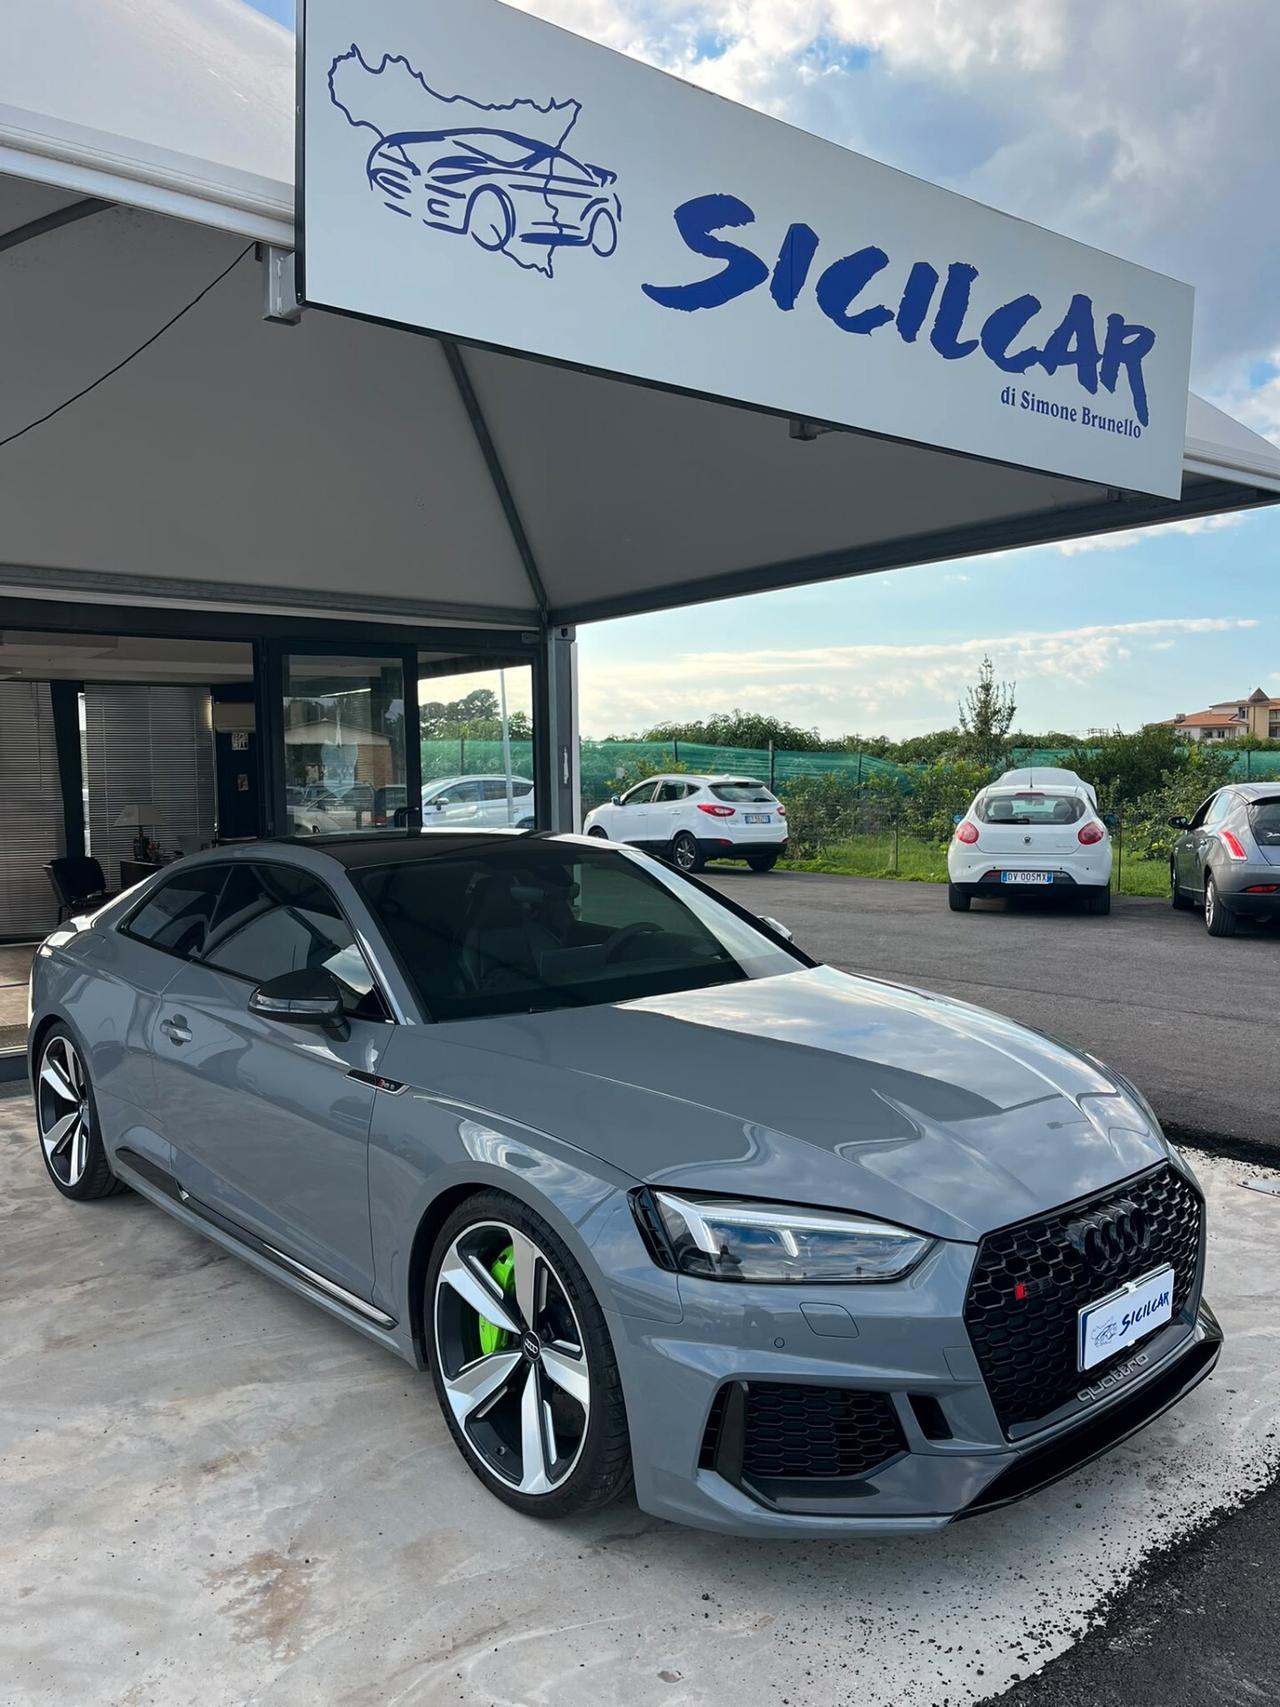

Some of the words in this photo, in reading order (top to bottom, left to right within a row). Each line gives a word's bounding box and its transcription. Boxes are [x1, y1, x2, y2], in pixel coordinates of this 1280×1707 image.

[641, 193, 1156, 427] SICILCAR
[1001, 386, 1016, 406] di
[1020, 390, 1077, 422] Simone
[1082, 407, 1141, 439] Brunello
[1118, 1291, 1169, 1337] SICILCAR
[1076, 1353, 1149, 1402] quattro
